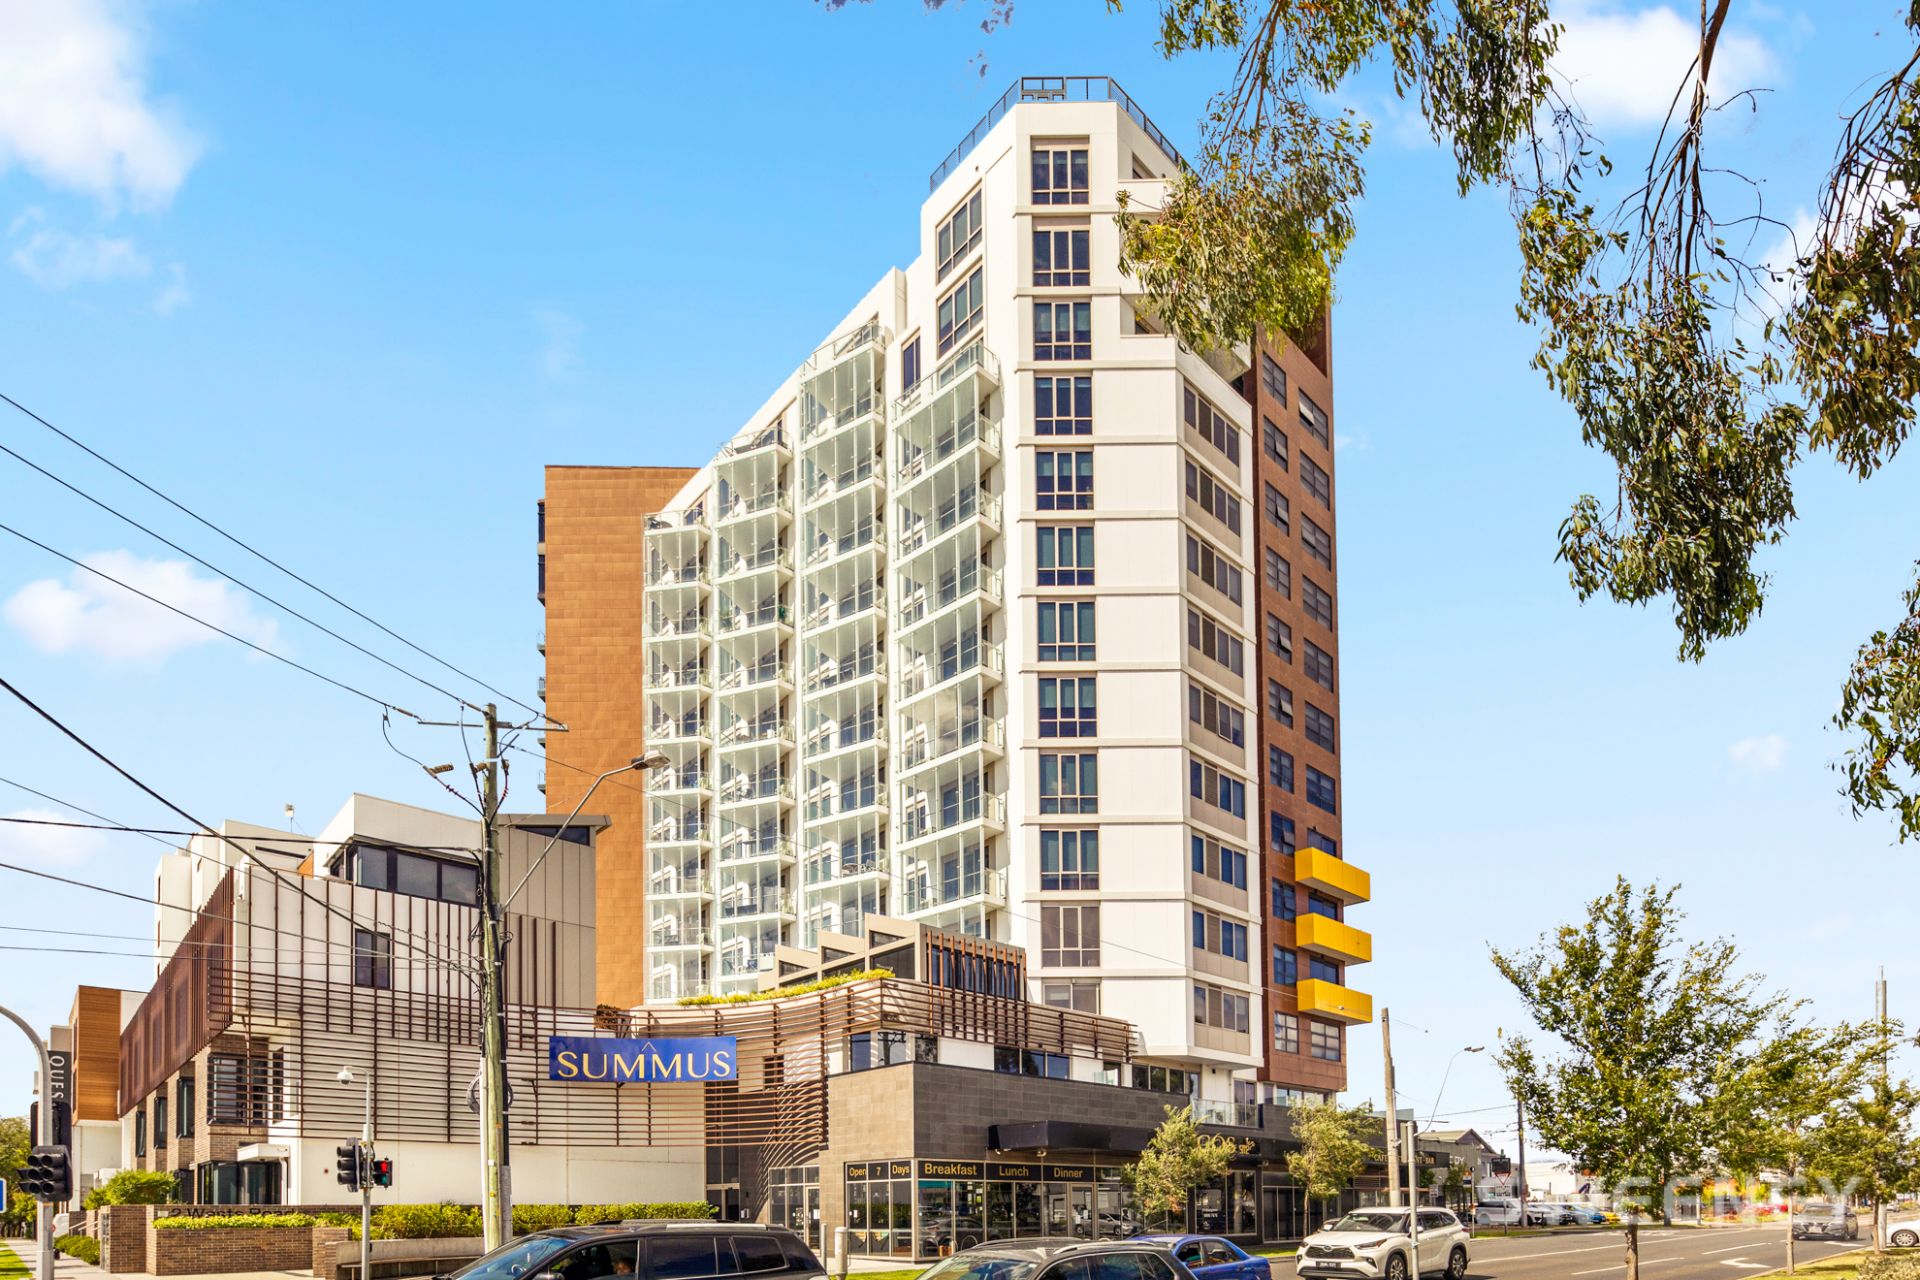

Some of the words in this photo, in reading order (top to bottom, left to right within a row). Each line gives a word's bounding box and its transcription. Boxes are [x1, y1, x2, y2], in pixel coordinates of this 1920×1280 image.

[557, 1050, 731, 1079] SUMMUS
[849, 1167, 867, 1177] Open
[875, 1167, 881, 1176] 7
[892, 1164, 910, 1175] Days
[924, 1163, 977, 1176] Breakfast
[999, 1165, 1029, 1177] Lunch
[1053, 1167, 1084, 1178] Dinner
